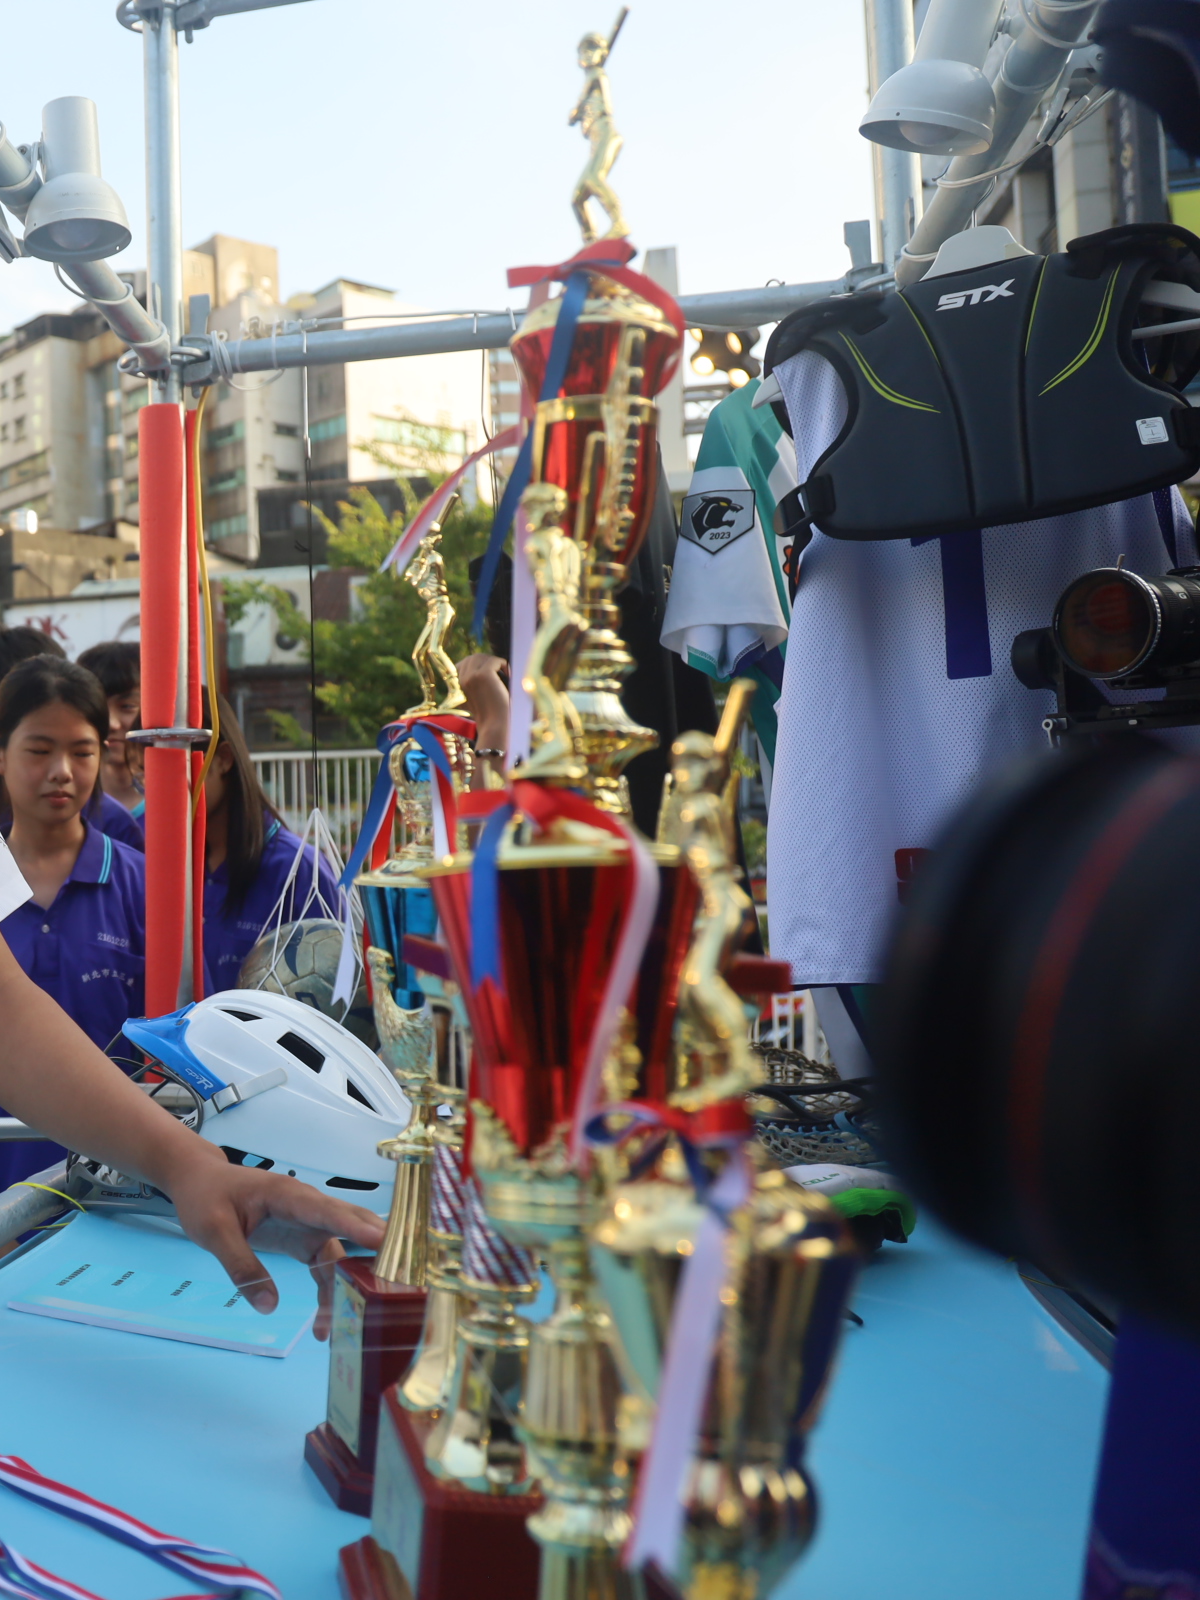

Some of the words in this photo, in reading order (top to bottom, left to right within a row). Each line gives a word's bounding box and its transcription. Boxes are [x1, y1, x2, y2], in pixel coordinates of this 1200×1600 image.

[935, 278, 1015, 311] STX
[709, 531, 731, 540] 2023
[100, 1190, 144, 1199] cascad
